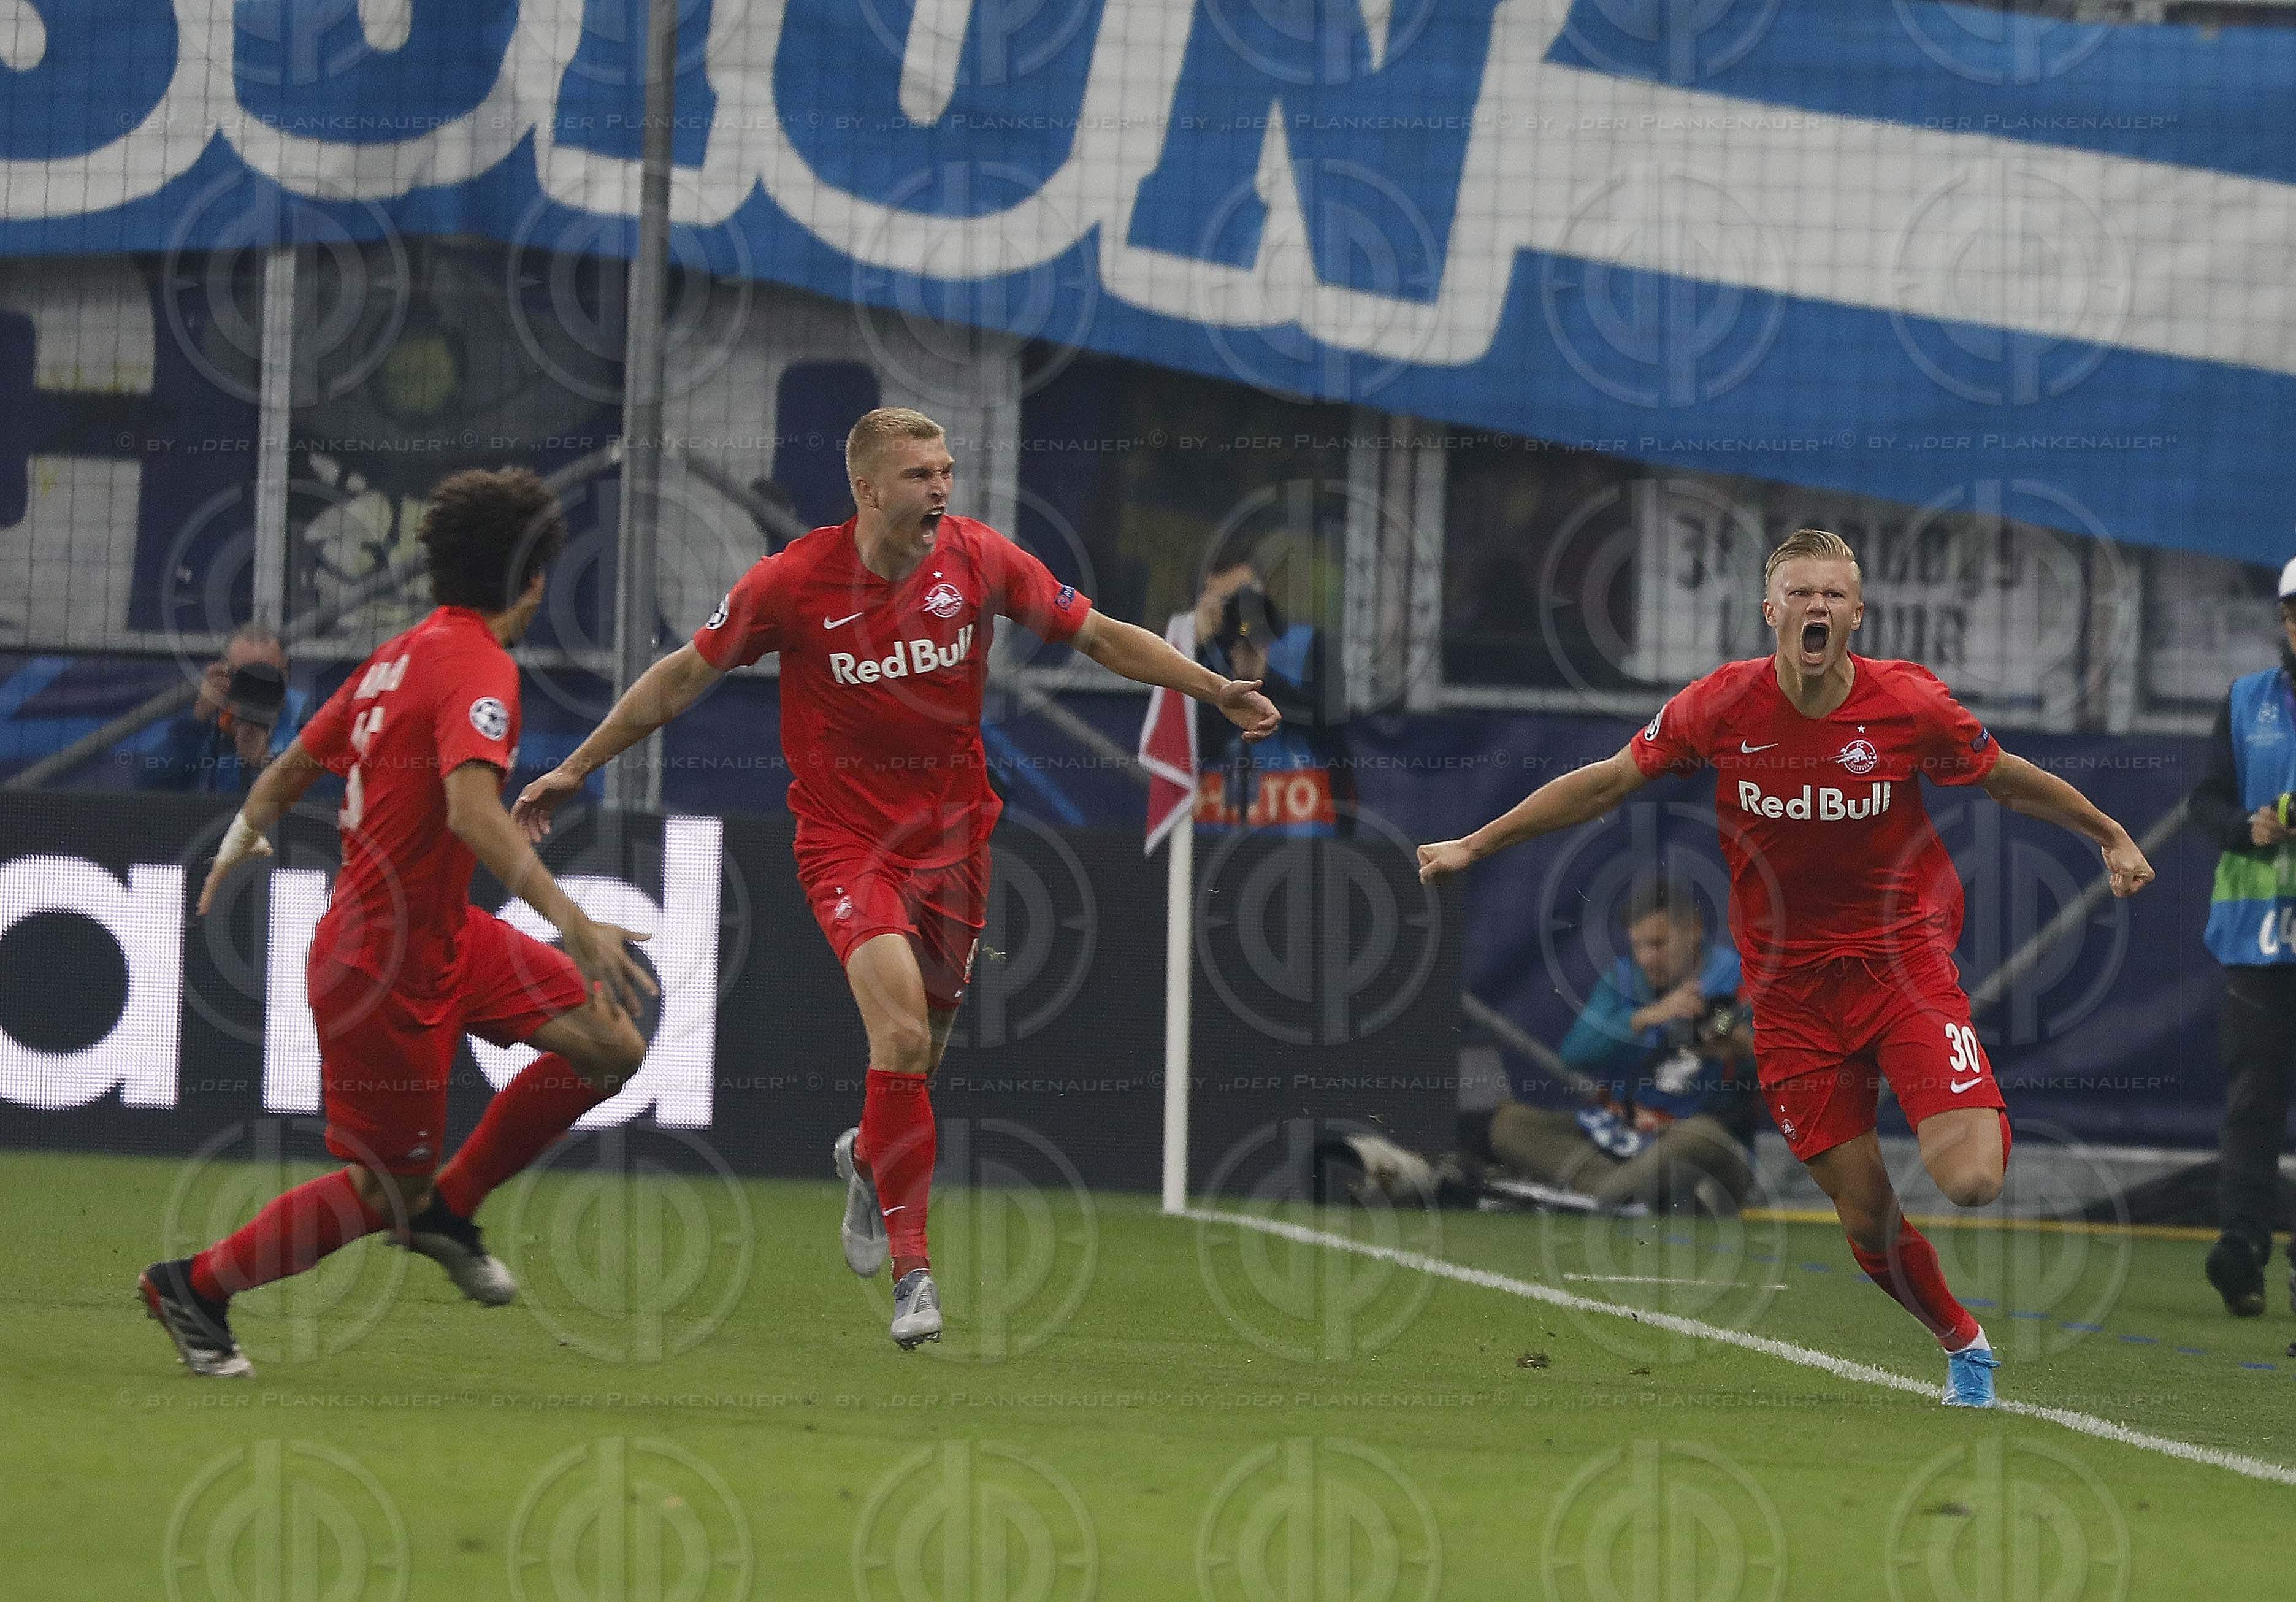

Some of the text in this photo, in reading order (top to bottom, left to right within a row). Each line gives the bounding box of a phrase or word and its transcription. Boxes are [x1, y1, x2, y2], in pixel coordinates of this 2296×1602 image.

[828, 623, 974, 684] Red Bull
[1738, 780, 1891, 821] Red Bull
[1945, 1022, 1980, 1073] 30
